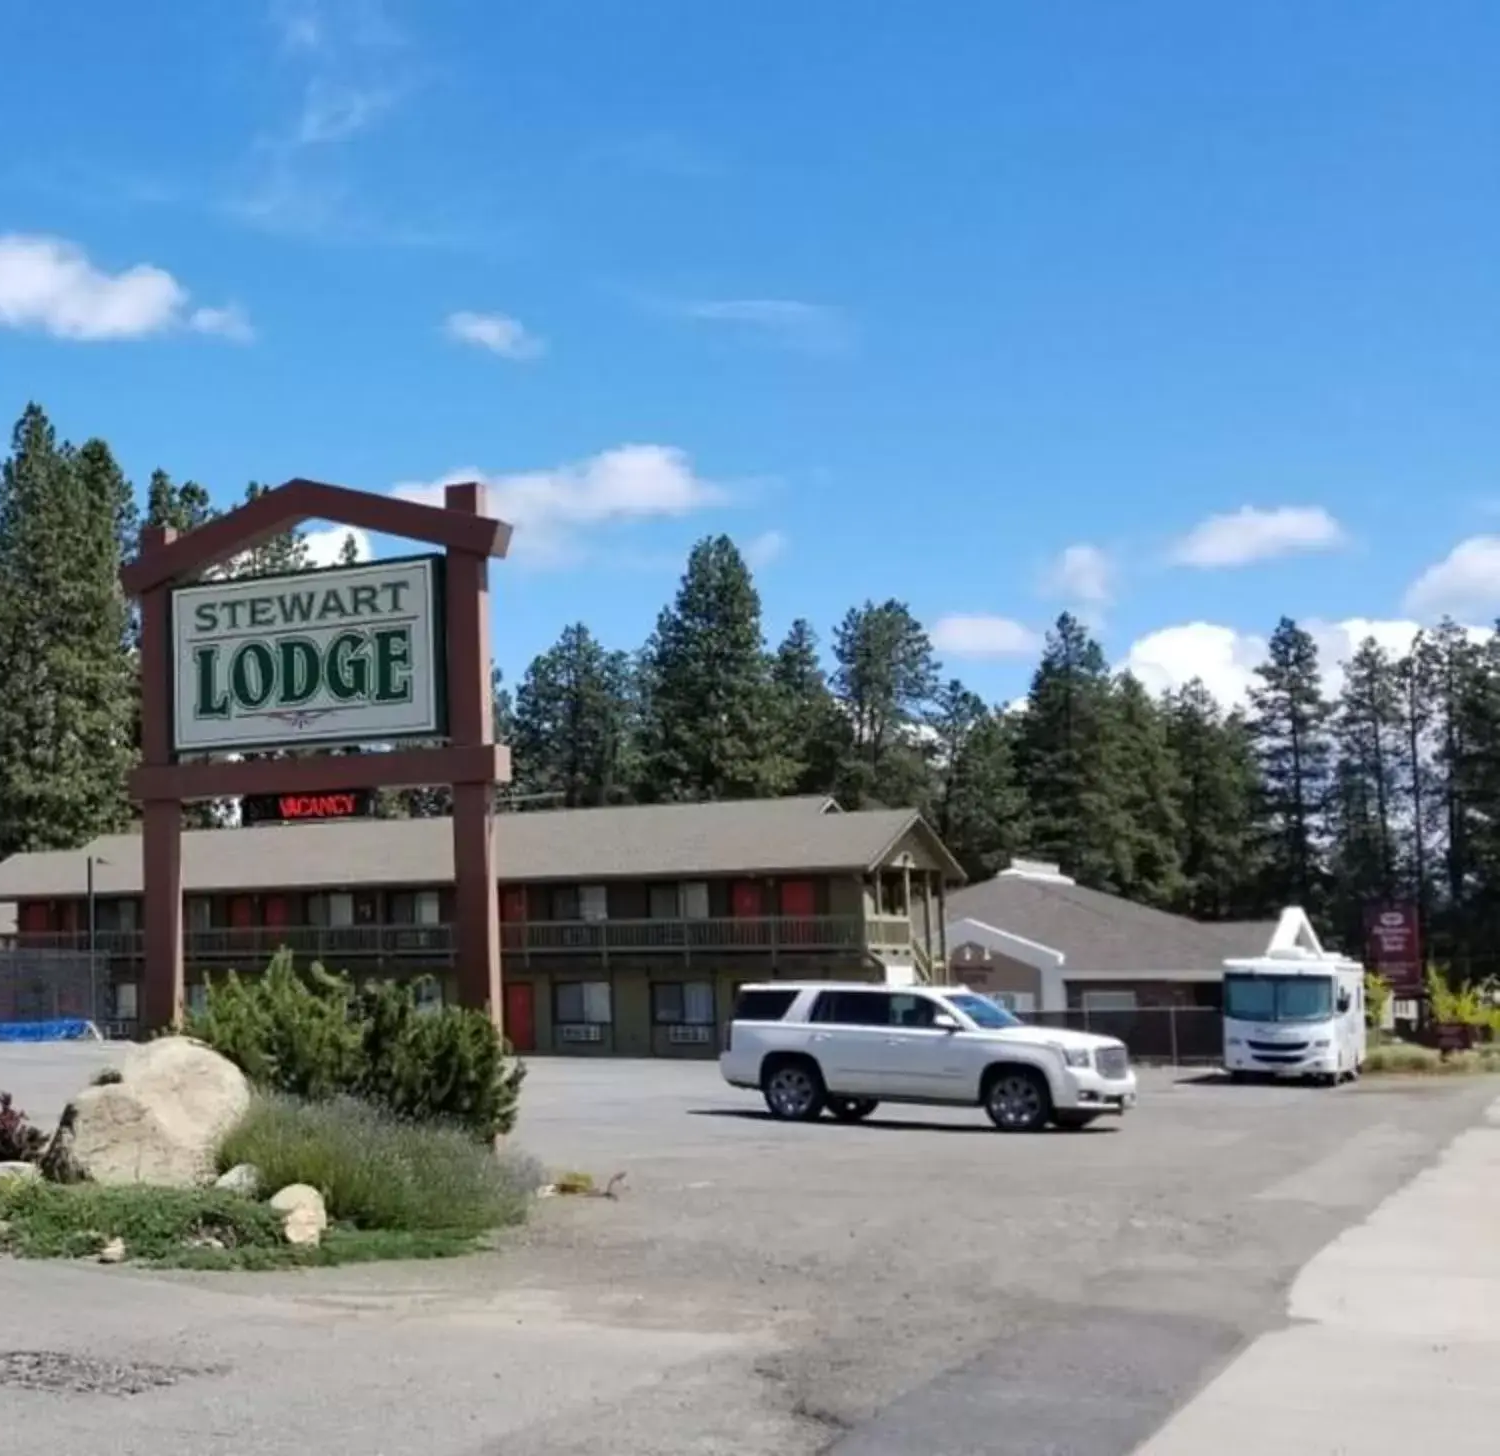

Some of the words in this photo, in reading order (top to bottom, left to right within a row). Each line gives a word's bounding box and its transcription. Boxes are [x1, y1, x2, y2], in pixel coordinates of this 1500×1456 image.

[194, 581, 409, 632] STEWART
[194, 624, 413, 720] LODGE
[279, 794, 356, 817] VACANCY
